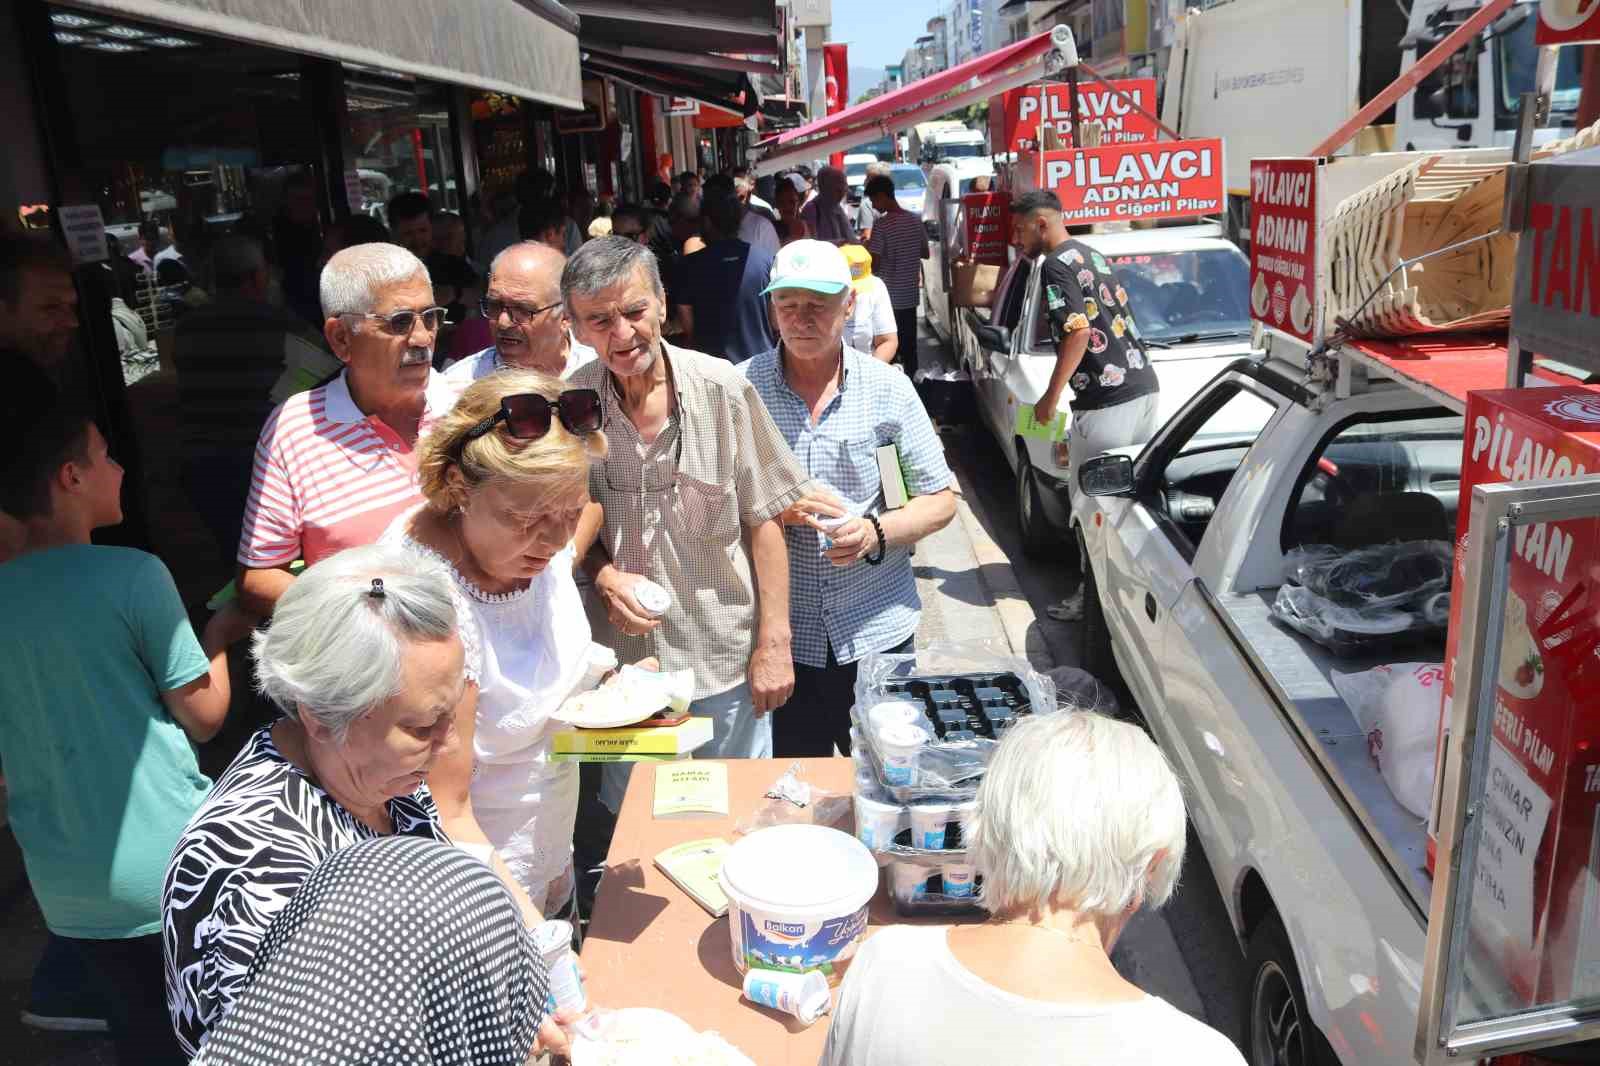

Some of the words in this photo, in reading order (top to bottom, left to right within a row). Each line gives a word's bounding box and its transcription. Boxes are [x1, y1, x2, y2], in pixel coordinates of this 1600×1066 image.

[1046, 149, 1213, 189] PİLAVCI
[1254, 164, 1312, 208] PİLAVCI
[1083, 181, 1179, 204] ADNAN
[1115, 200, 1172, 216] Ciğerli
[1176, 198, 1217, 211] Pilav
[1256, 214, 1308, 254] ADNAN
